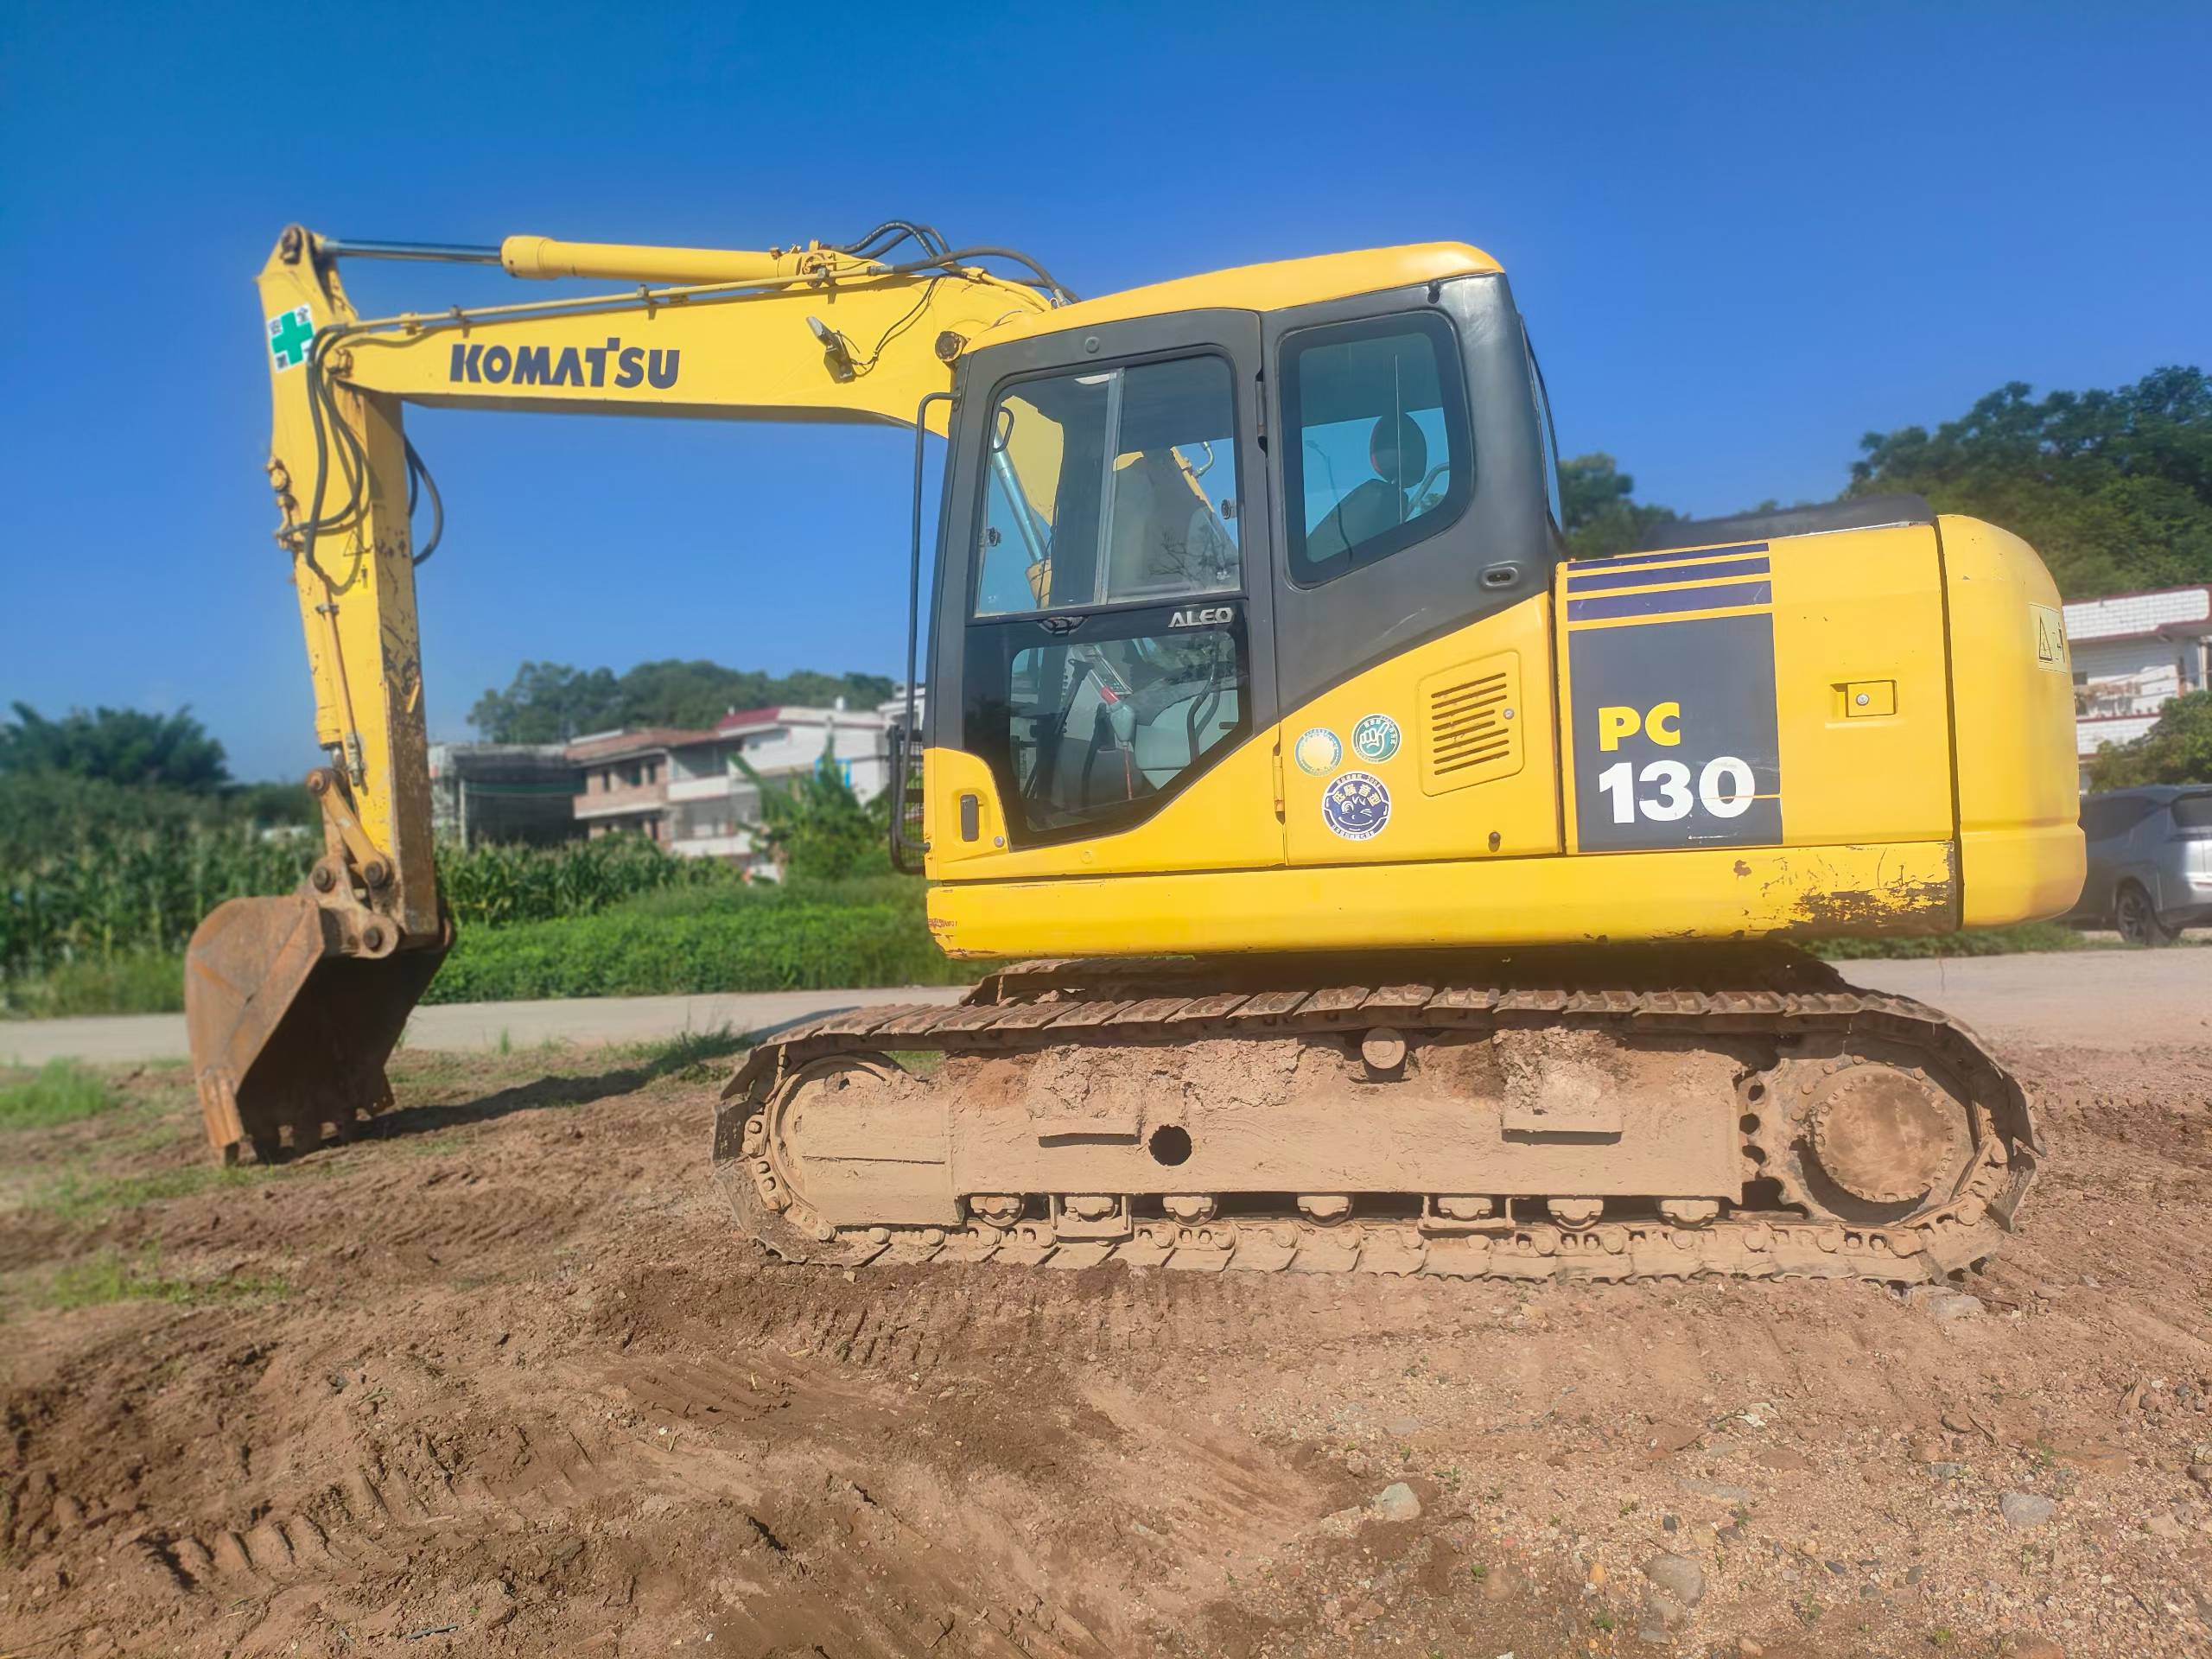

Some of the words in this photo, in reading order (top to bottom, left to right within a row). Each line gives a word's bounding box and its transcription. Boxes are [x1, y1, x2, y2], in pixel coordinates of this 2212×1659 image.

[448, 337, 680, 389] KOMATSU
[1598, 702, 1681, 752] PC
[1598, 756, 1756, 823] 130
